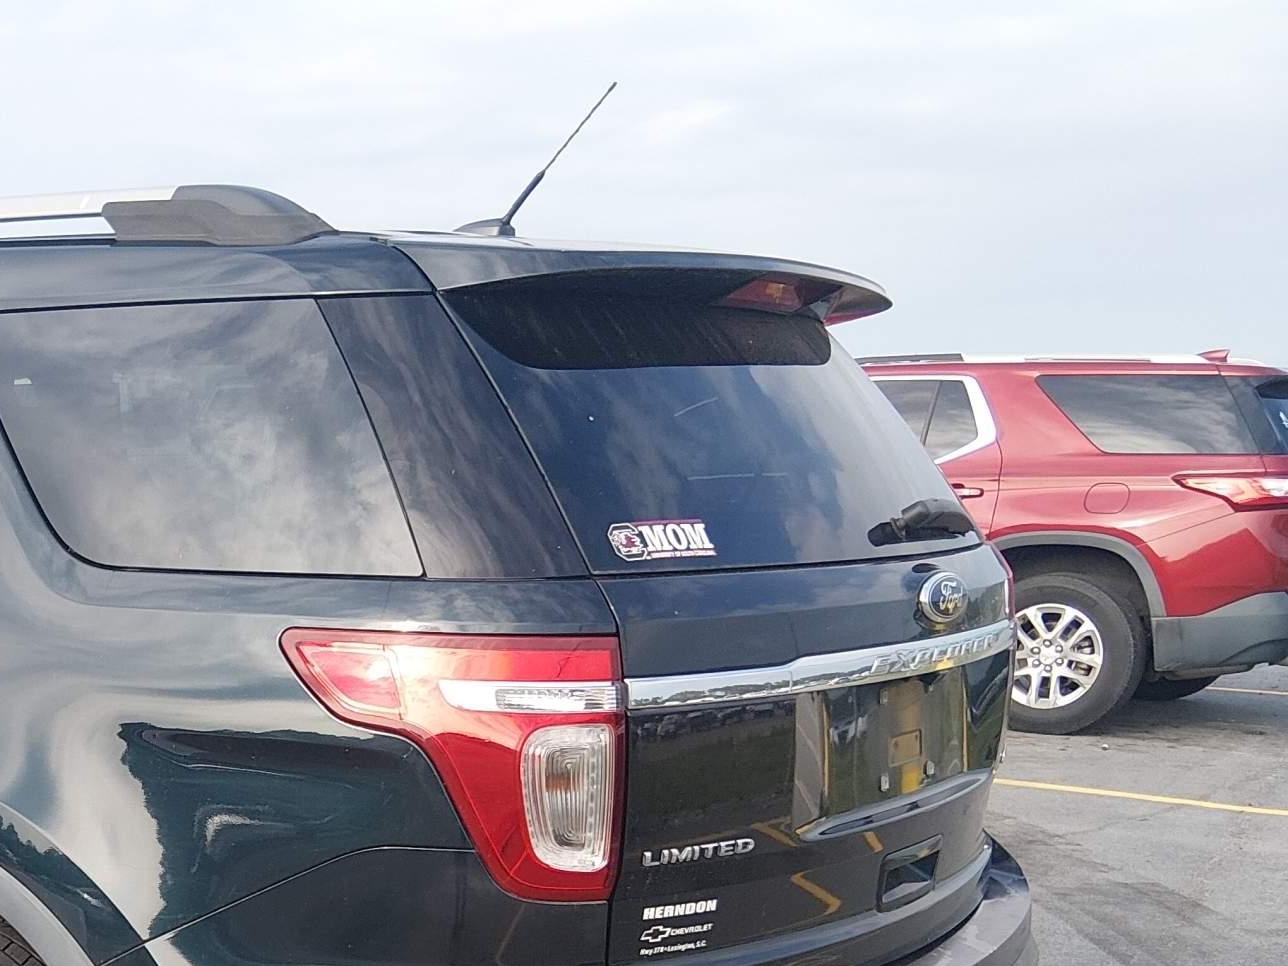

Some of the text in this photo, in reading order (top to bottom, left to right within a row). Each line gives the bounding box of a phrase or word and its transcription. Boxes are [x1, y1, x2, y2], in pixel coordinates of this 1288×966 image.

[637, 523, 715, 552] MOM
[938, 580, 967, 611] Ford
[870, 632, 1000, 674] EXPLORER
[641, 838, 756, 867] LIMITED
[642, 899, 718, 921] HERNDON
[669, 922, 715, 936] CHEVROLET
